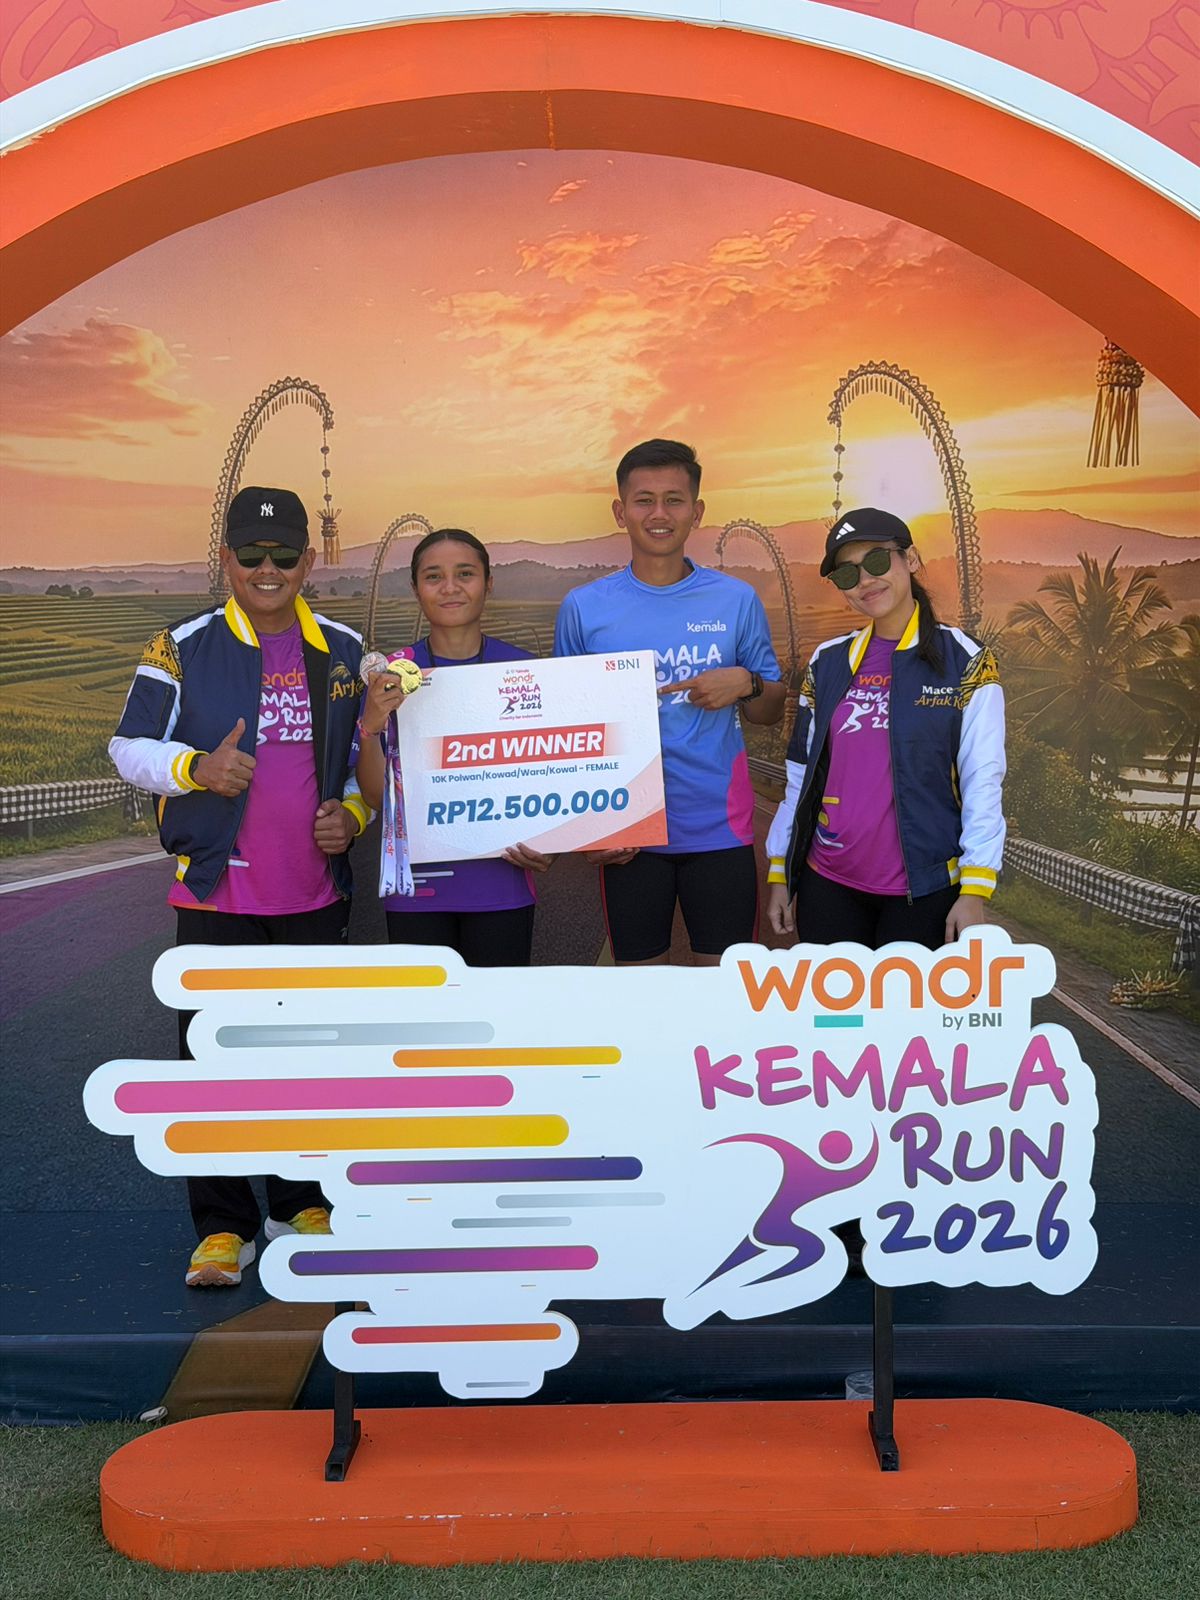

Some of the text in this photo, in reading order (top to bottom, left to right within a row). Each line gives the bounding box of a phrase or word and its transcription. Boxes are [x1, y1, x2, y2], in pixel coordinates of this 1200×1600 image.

[686, 620, 726, 632] Kemala
[654, 644, 722, 667] MALA
[617, 658, 640, 670] BNI
[502, 673, 534, 684] wondr
[498, 684, 540, 695] KEMALA
[846, 688, 890, 702] KEMA
[922, 686, 954, 694] Mace
[522, 693, 541, 702] RUN
[914, 695, 952, 707] Arfak
[520, 700, 542, 710] 2026
[278, 728, 314, 742] 202
[446, 731, 603, 762] 2nd WINNER
[432, 774, 447, 784] 10K
[448, 765, 578, 782] Polwan/Kowad/Wara/Kowal
[586, 762, 620, 771] FEMALE
[427, 787, 630, 826] RP12.500.000
[737, 938, 1025, 1012] wondr
[942, 1012, 1002, 1030] by BNI
[694, 1034, 1070, 1114] KEMALA
[889, 1112, 1065, 1189] RUN
[876, 1180, 1070, 1261] 2026
